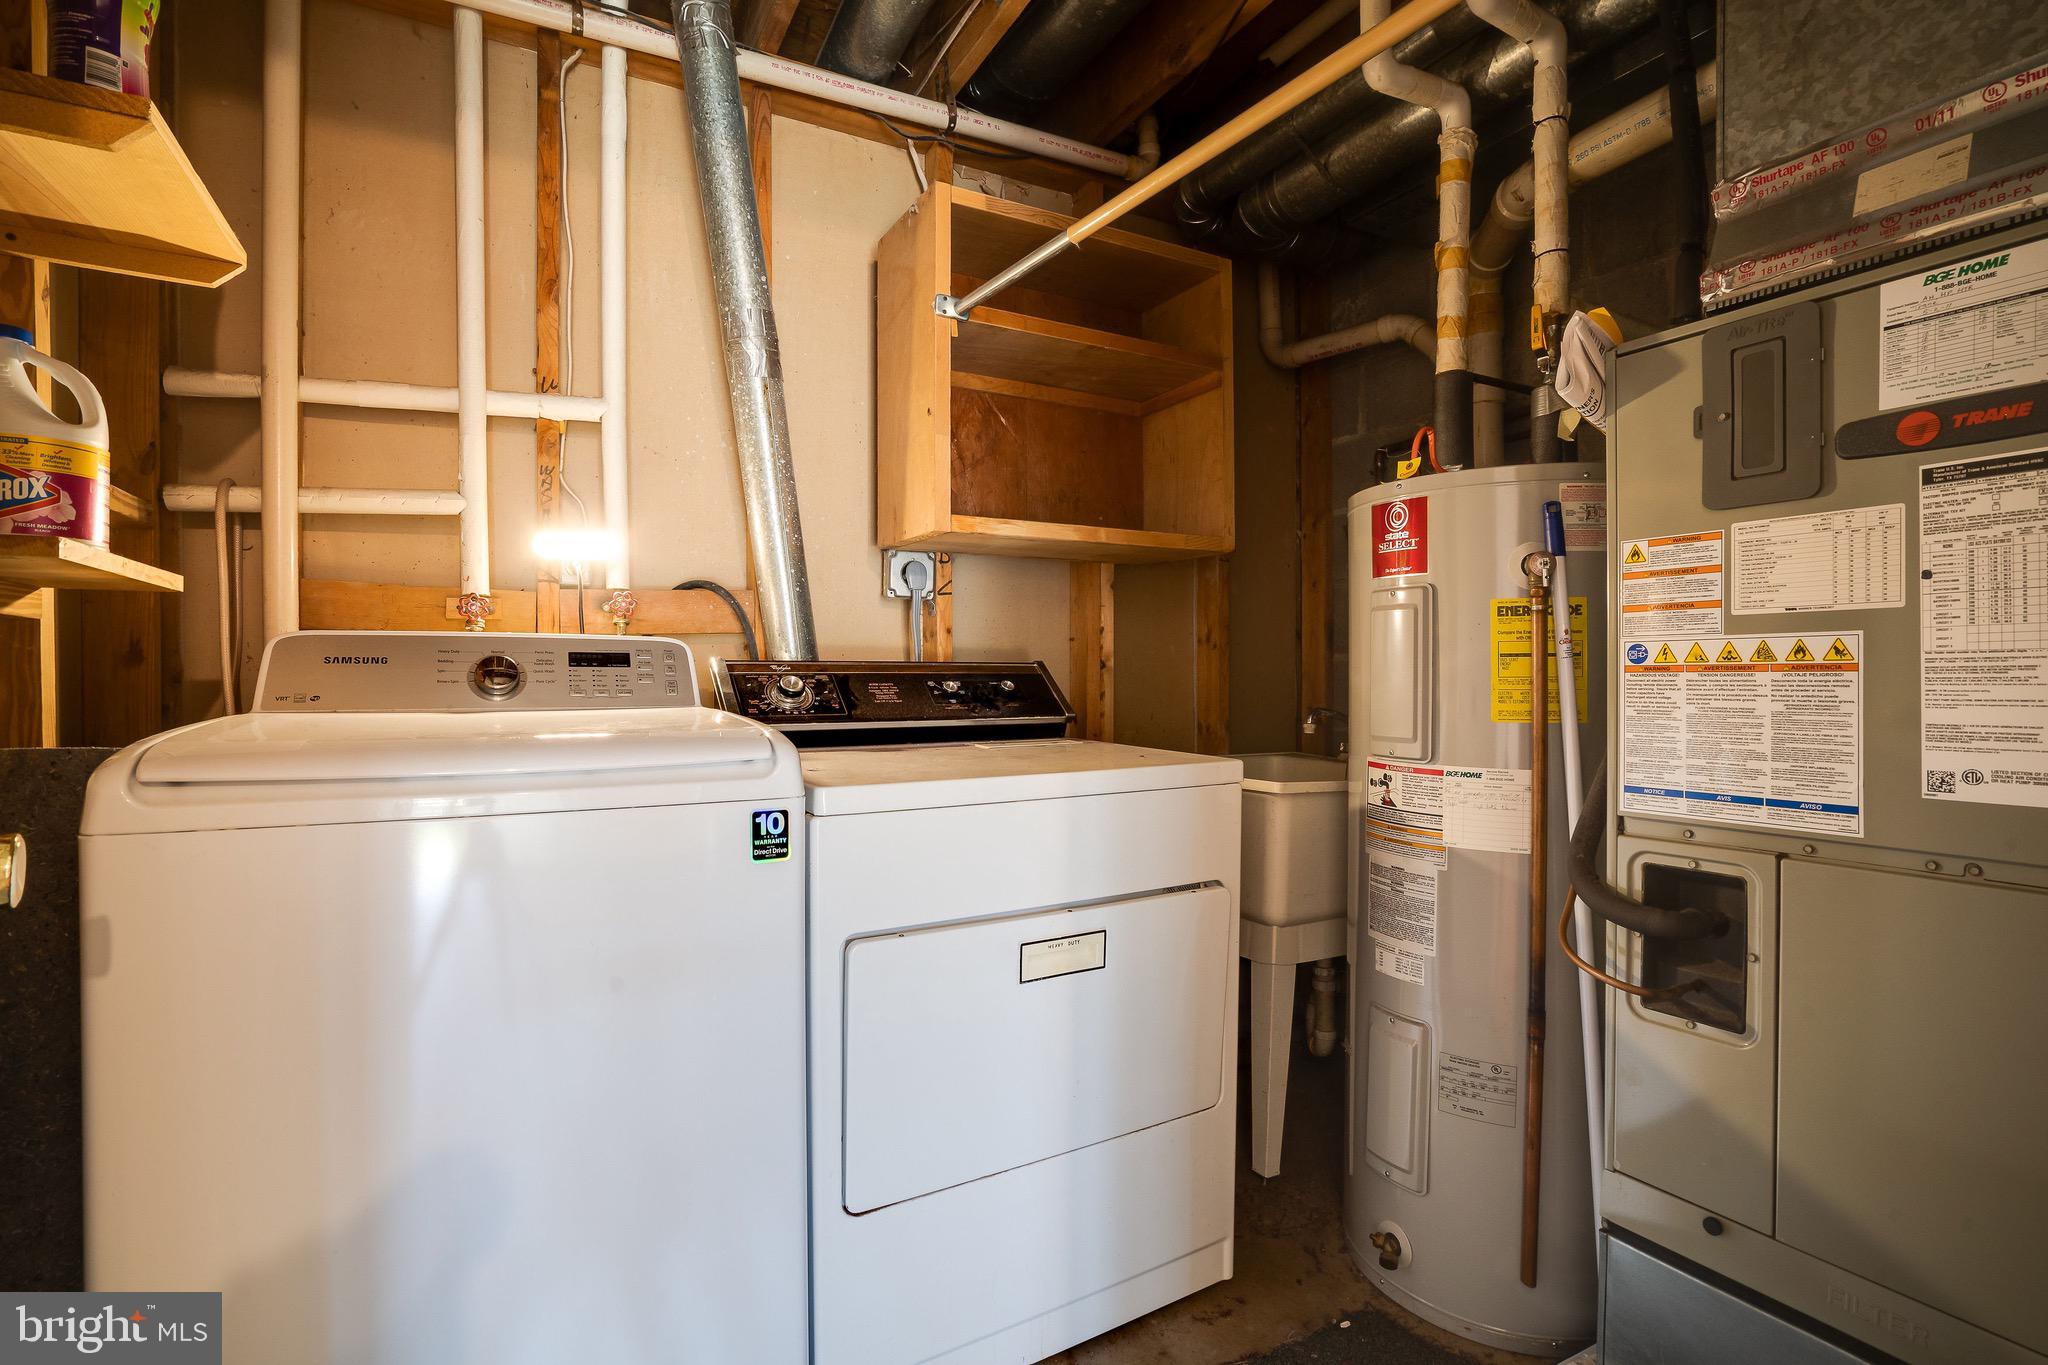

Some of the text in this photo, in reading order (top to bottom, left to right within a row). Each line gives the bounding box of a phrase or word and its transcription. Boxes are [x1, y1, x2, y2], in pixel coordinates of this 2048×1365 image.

[1914, 106, 1954, 132] 01/11
[1604, 128, 1631, 148] ASTM-D
[1751, 140, 1855, 188] Shurtape AF 100
[1752, 180, 1789, 200] 181A-P
[1800, 159, 1846, 184] 181B-FX
[1908, 208, 1956, 230] 181A-P
[1972, 184, 2032, 210] 181B-FX
[1909, 191, 1977, 217] Shurtape
[1988, 176, 2012, 192] AF
[1760, 241, 1816, 264] Shurtape
[1824, 232, 1841, 243] AF
[1760, 257, 1798, 276] 181A-P
[1811, 240, 1858, 260] 181B-FX
[1923, 253, 2012, 287] BGE HOME
[1934, 271, 1998, 292] 1-888-BGE-HOME
[1952, 401, 2034, 428] TRANE
[1378, 538, 1417, 551] SELECT
[1385, 530, 1409, 540] state
[1649, 568, 1698, 577] AVERTISSEMENT
[324, 656, 388, 664] SAMSUNG
[756, 812, 785, 835] 10
[754, 838, 787, 846] WARRANTY
